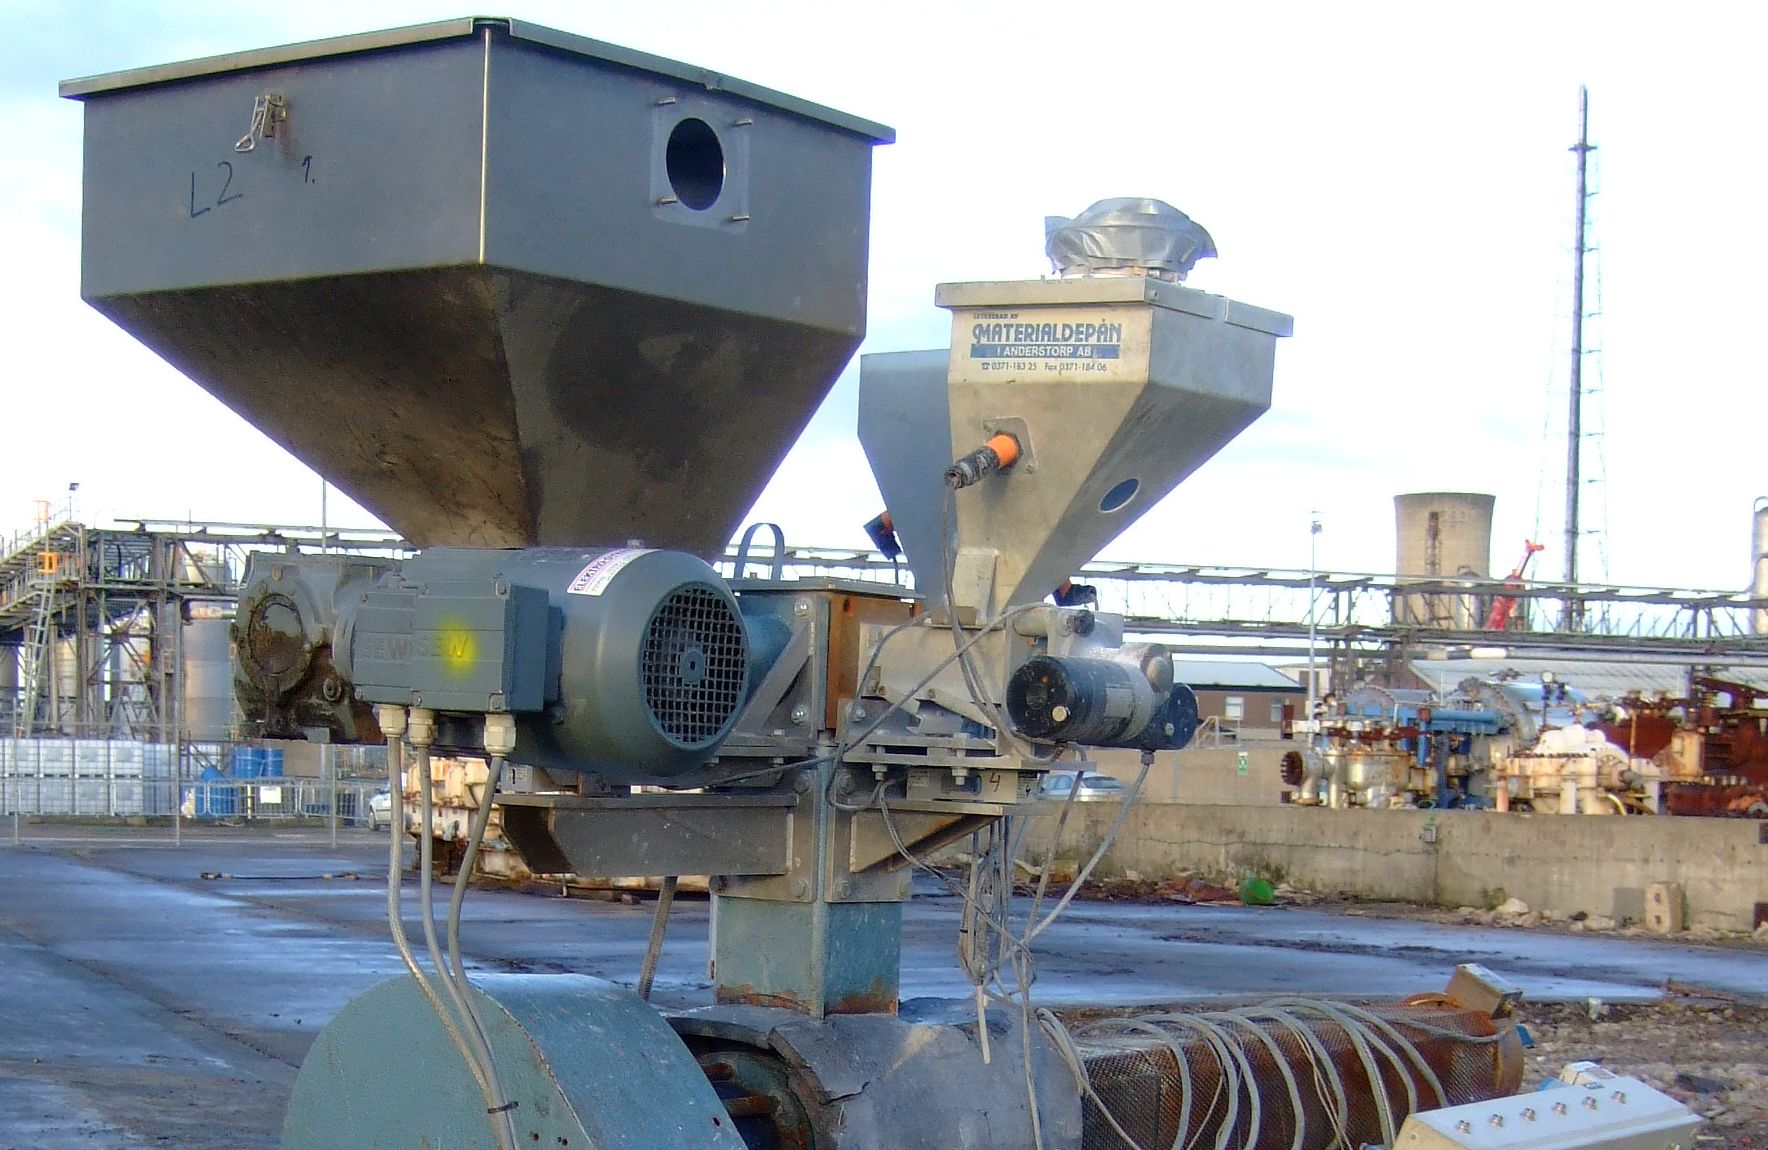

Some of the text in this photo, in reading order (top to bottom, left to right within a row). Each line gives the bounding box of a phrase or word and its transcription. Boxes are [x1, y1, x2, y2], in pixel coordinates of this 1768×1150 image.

[191, 160, 244, 218] L2
[1003, 346, 1073, 357] ANDERSTORP
[1076, 346, 1092, 357] AB
